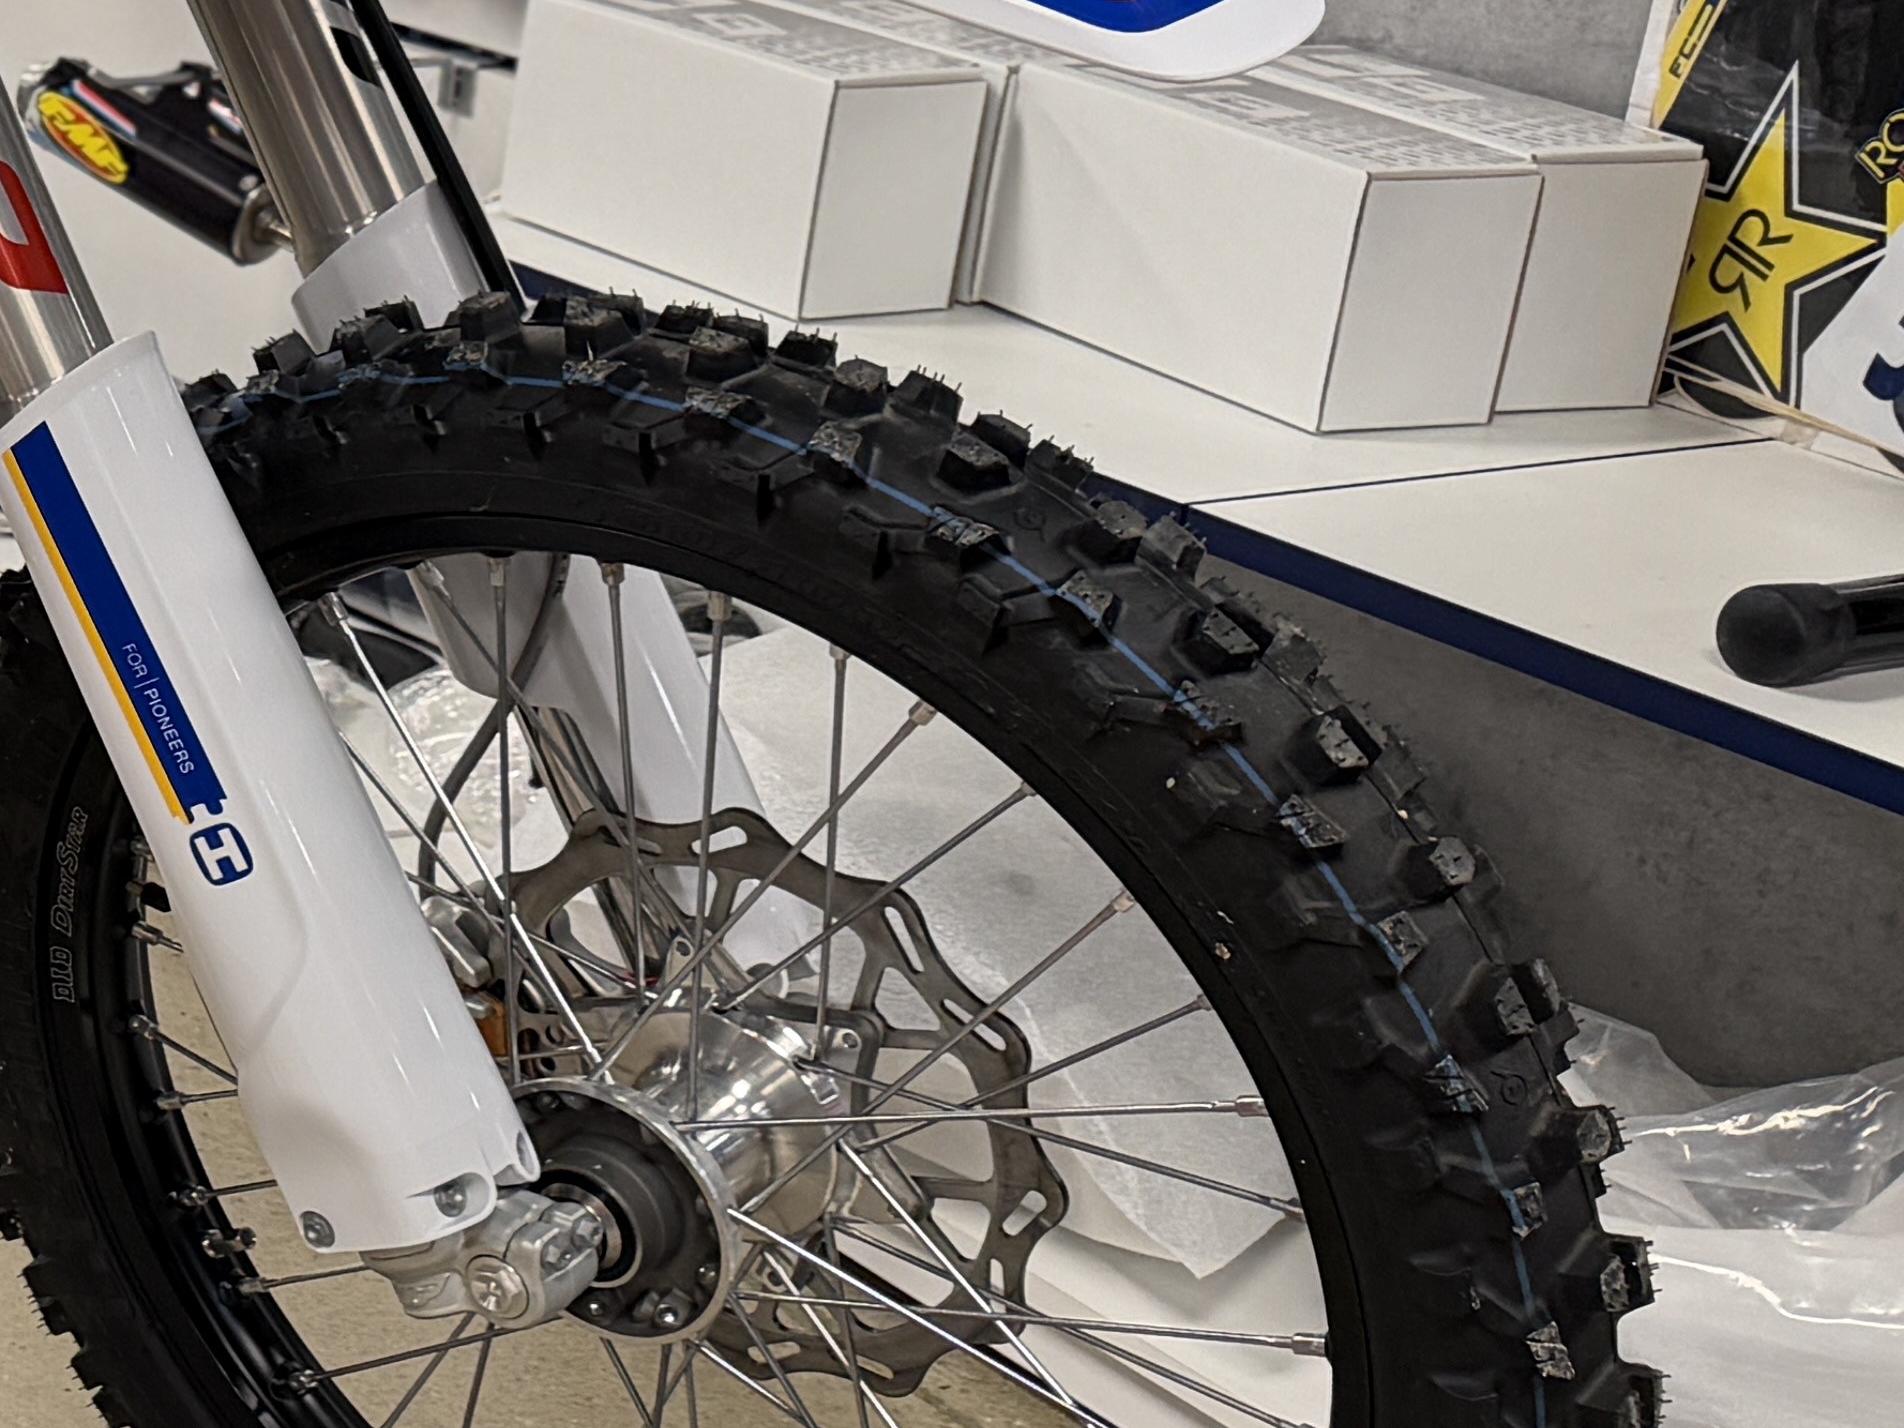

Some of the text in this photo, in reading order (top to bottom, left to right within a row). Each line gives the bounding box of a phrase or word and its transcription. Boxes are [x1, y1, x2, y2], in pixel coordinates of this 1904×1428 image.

[38, 94, 129, 181] FMF
[122, 642, 195, 774] FOR PIONEERS
